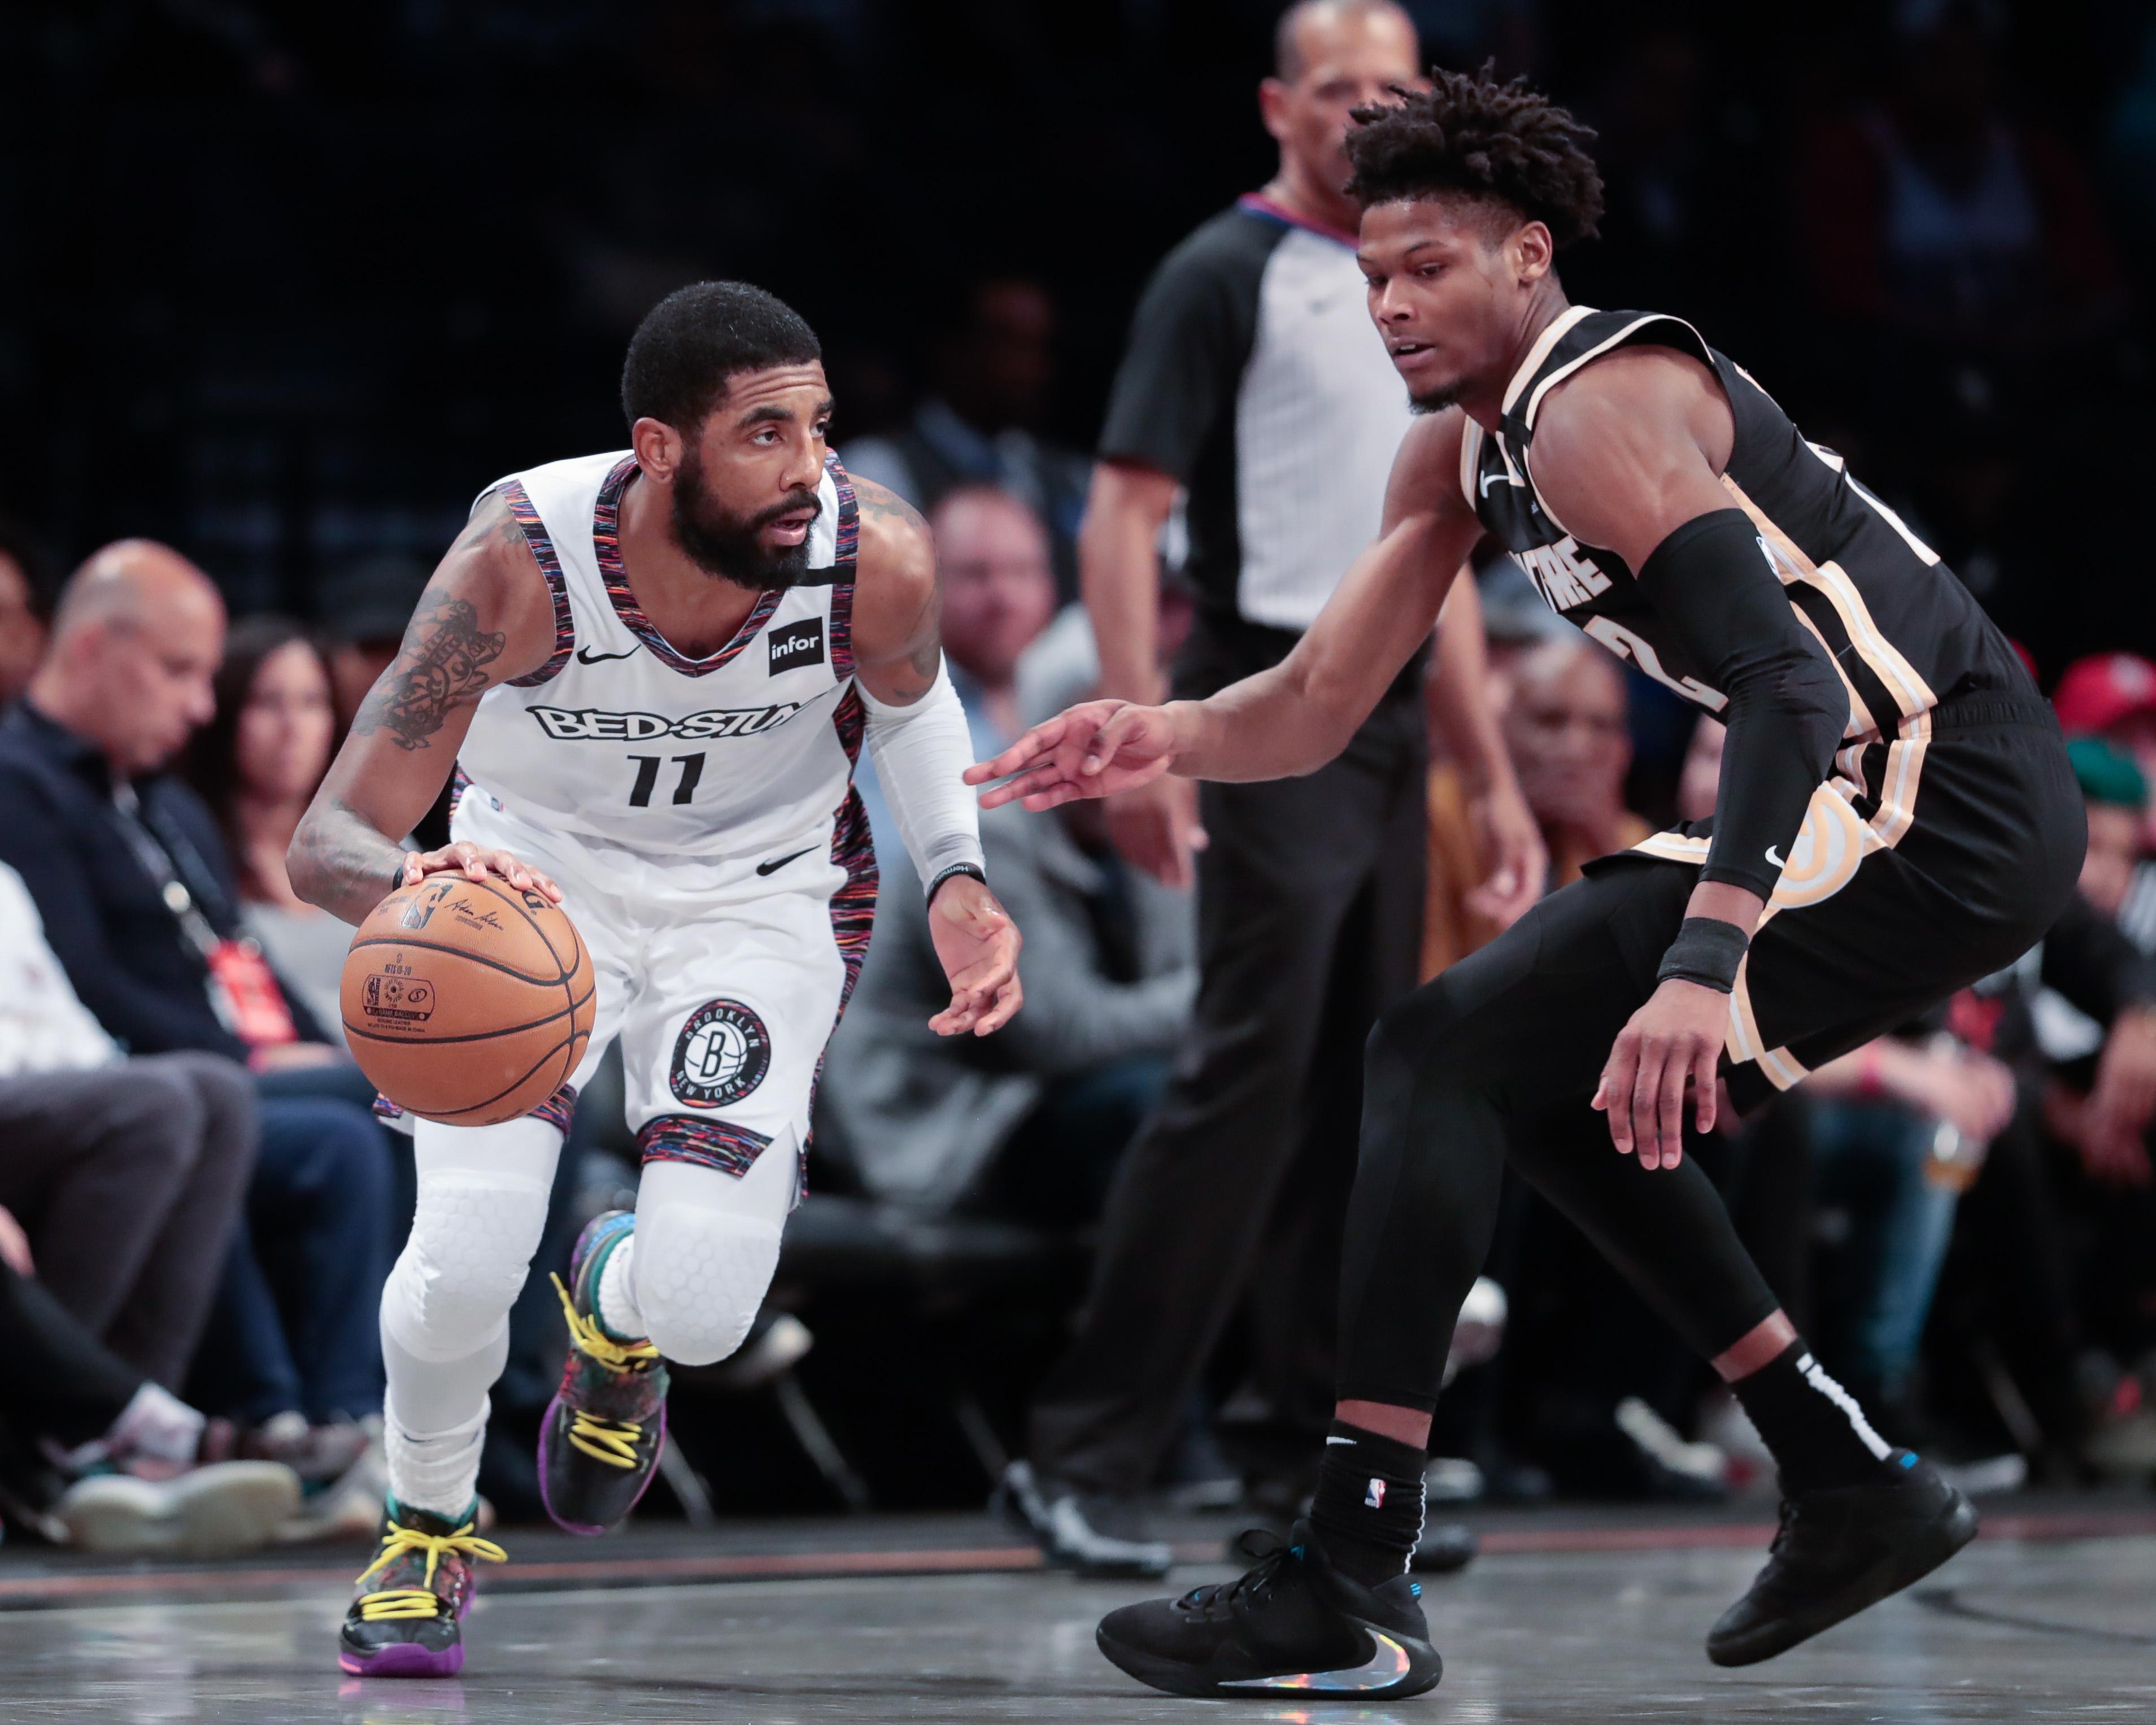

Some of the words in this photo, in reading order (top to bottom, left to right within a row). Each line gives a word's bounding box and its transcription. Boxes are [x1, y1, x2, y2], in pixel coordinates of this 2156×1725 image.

[772, 634, 819, 660] infor
[1583, 615, 1728, 713] 2
[627, 752, 705, 807] 11
[685, 1008, 760, 1048] BROOKLYN
[700, 1031, 726, 1077] B
[676, 1070, 697, 1096] NEW
[704, 1075, 746, 1099] YORK
